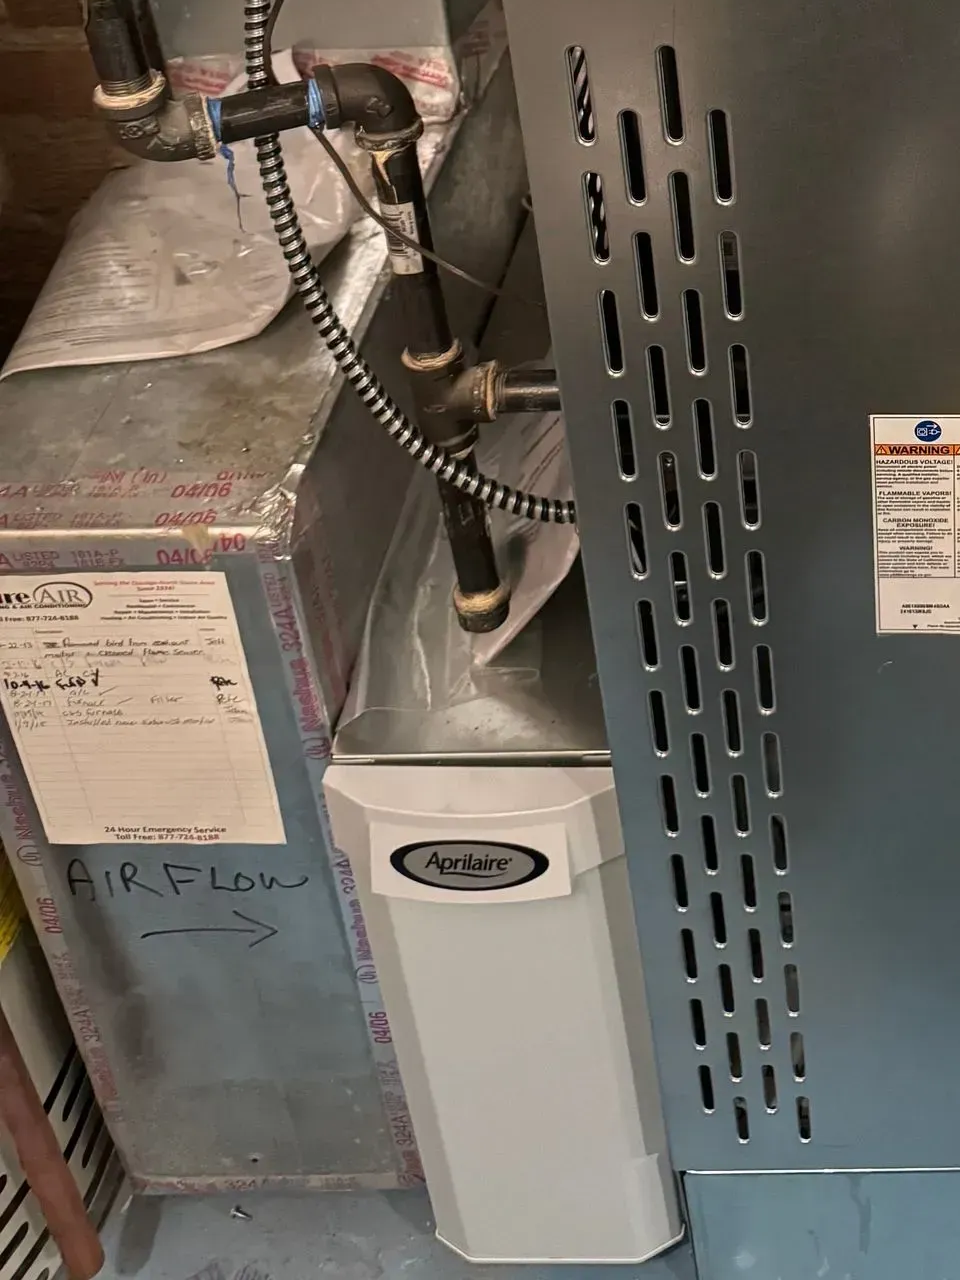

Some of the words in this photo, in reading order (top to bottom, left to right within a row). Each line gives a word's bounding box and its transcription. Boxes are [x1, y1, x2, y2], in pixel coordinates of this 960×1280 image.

[888, 446, 950, 455] WARNING
[142, 826, 192, 834] Emergency
[194, 825, 227, 834] Service
[368, 1010, 393, 1045] 04/06
